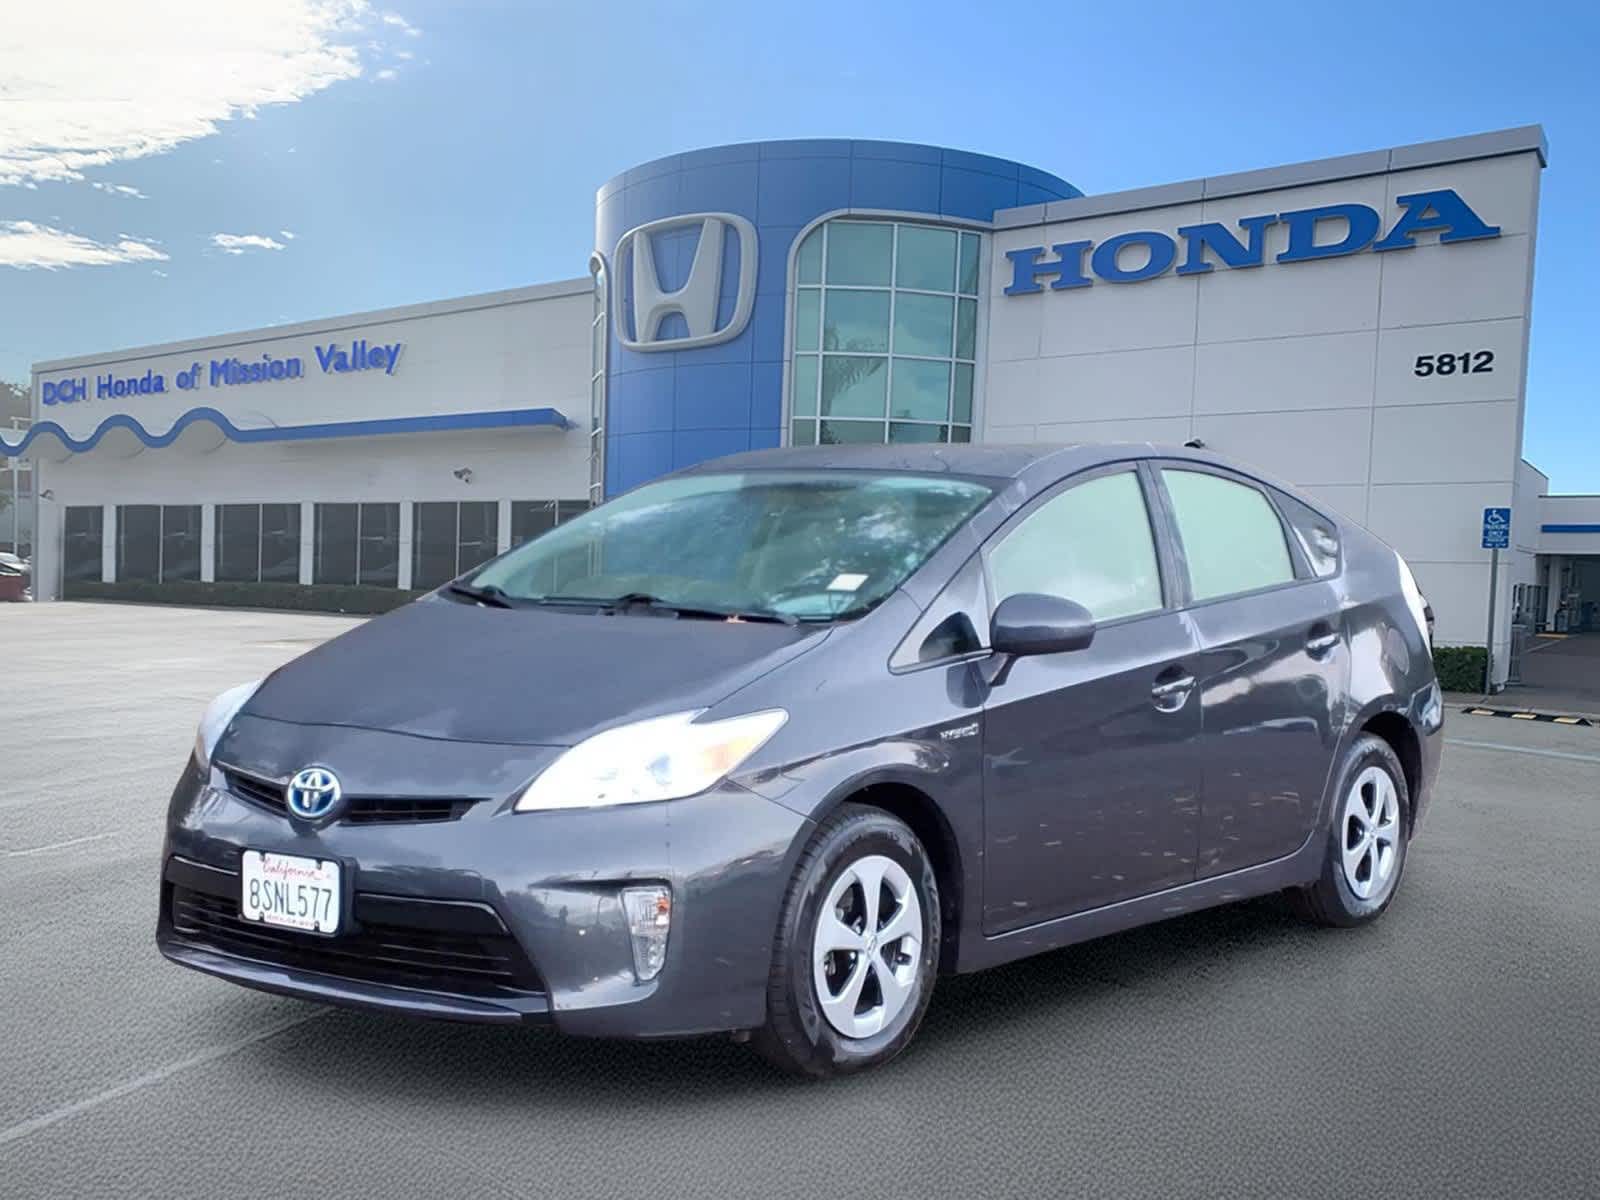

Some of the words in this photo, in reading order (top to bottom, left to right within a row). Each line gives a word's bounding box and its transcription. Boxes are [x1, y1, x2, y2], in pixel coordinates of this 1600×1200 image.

[1003, 189, 1501, 296] HONDA
[42, 378, 87, 406] DCH
[97, 369, 165, 400] Honda
[176, 364, 200, 390] of
[209, 353, 302, 387] Mission
[315, 340, 402, 376] Valley
[1413, 351, 1495, 377] 5812
[249, 878, 333, 922] 8SNL577
